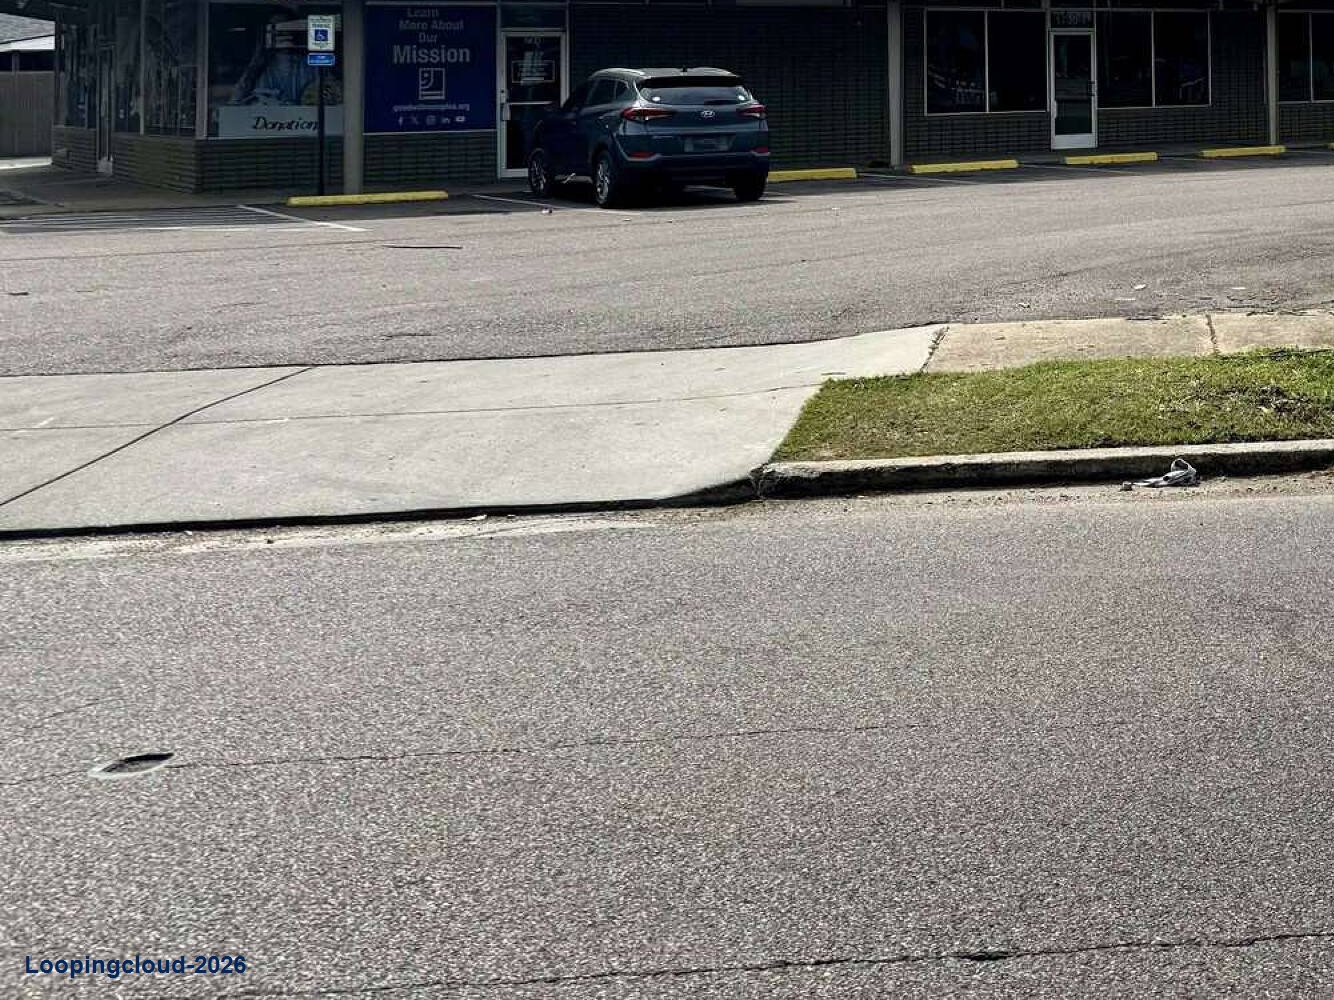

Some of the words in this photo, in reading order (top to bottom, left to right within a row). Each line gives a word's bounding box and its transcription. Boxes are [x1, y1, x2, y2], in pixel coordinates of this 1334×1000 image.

[407, 7, 439, 18] Learn
[399, 20, 428, 30] More
[431, 20, 464, 30] About
[419, 32, 438, 43] Our
[392, 45, 470, 64] Mission
